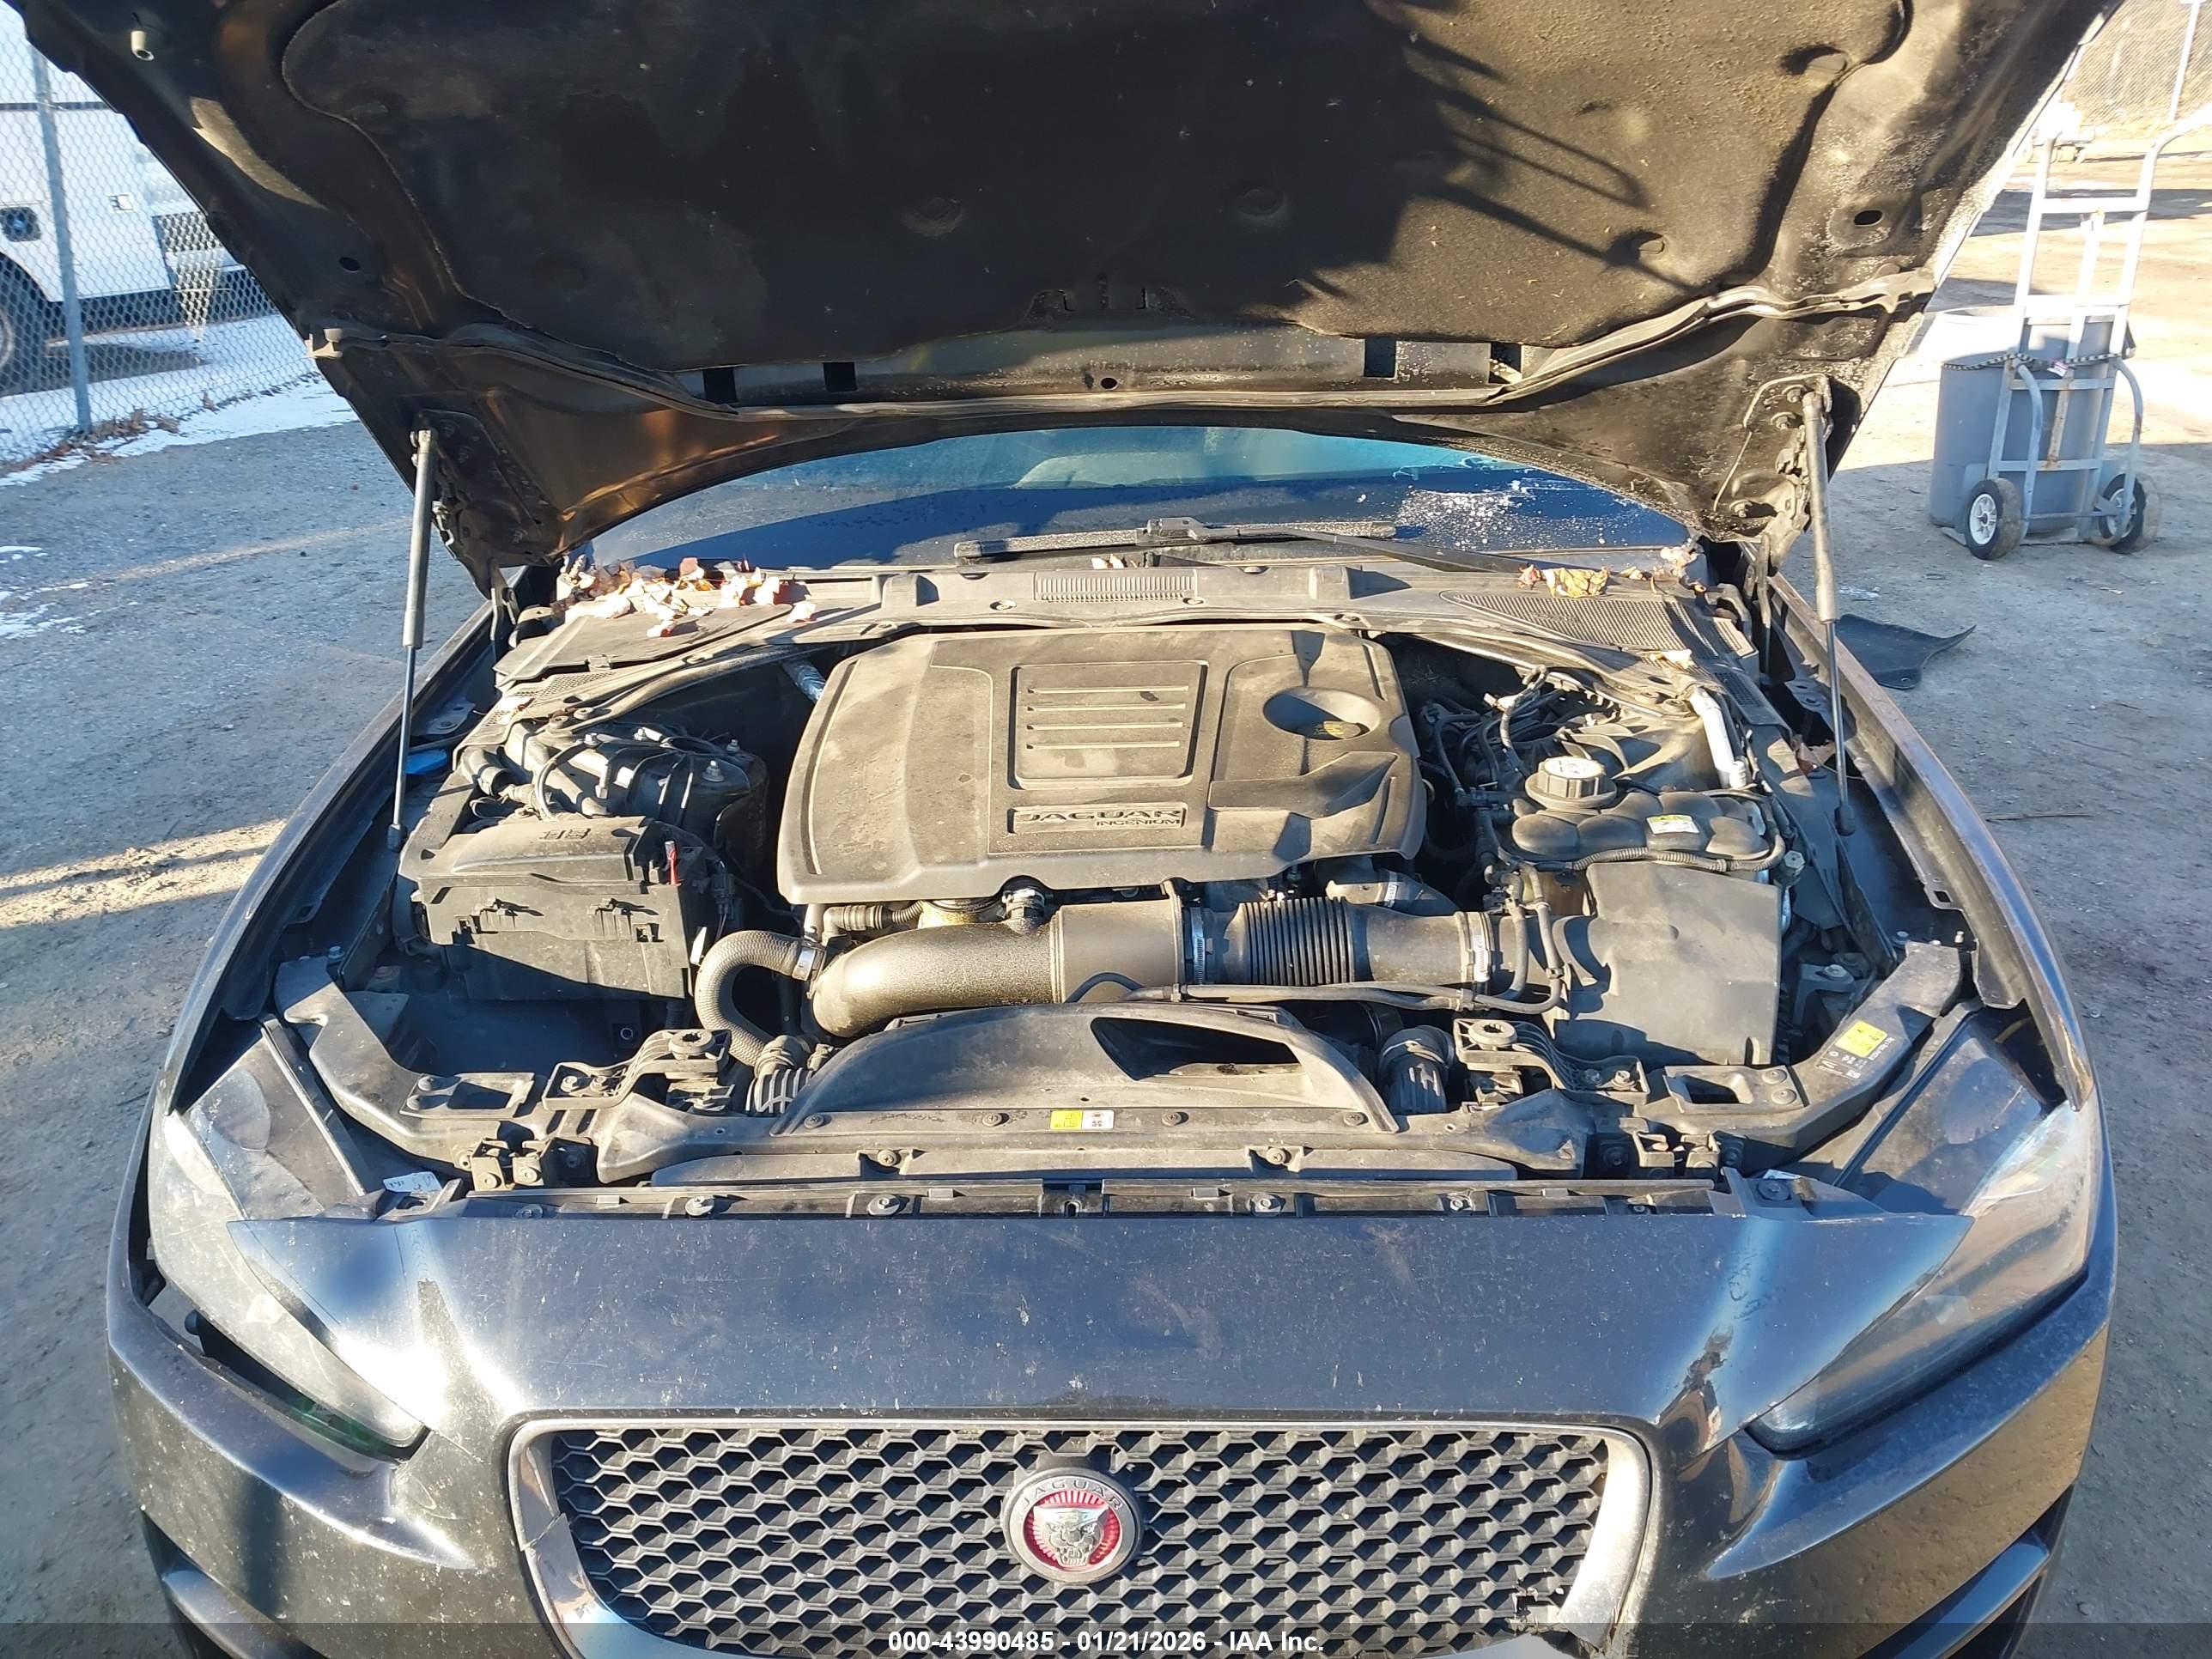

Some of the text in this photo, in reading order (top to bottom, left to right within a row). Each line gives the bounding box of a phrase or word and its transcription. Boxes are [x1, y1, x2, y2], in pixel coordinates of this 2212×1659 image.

[1015, 809, 1182, 823] JAGUAR
[1096, 818, 1181, 827] INGENIUM
[1022, 1479, 1124, 1510] JAGUAR
